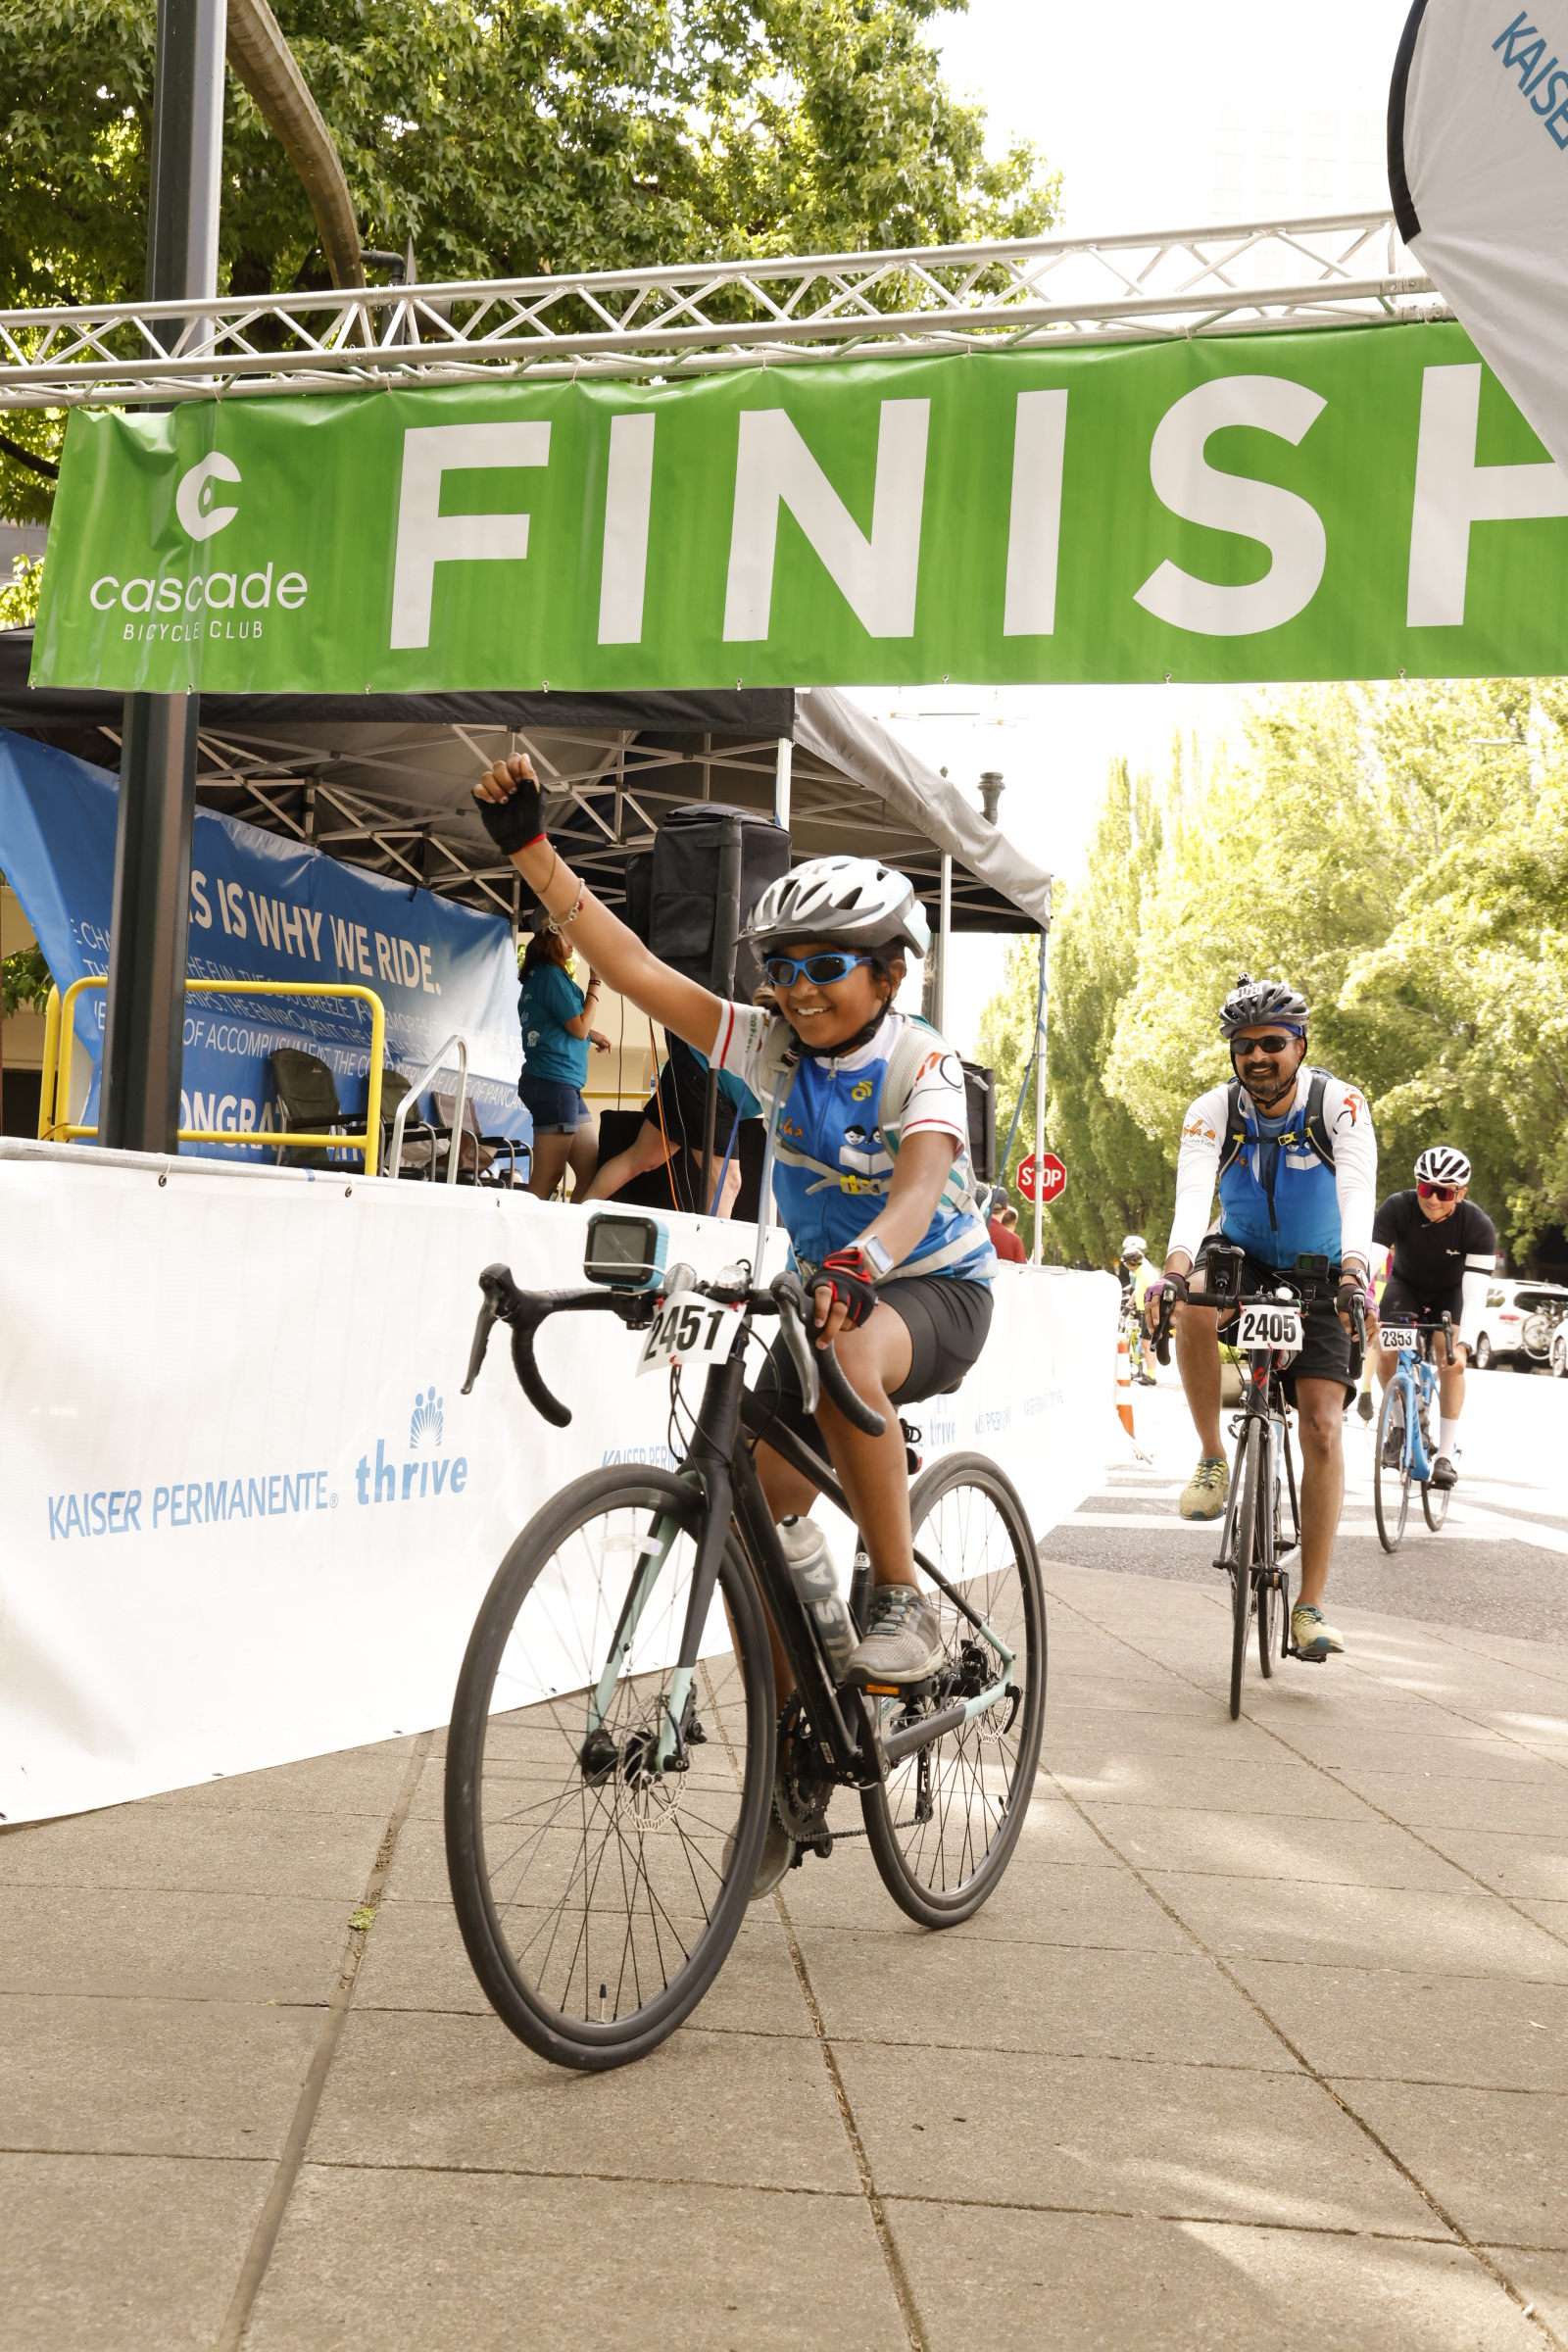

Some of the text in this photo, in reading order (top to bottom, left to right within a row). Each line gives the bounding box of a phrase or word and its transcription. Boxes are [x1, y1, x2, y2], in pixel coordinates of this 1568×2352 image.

[390, 364, 1568, 650] FINISH
[89, 563, 308, 612] cascade
[122, 620, 264, 643] BICYCLE CLUB
[218, 878, 247, 940] IS
[248, 890, 322, 962] WHY
[330, 914, 373, 977] WE
[375, 931, 441, 996] RIDE.
[183, 1018, 205, 1047] OF
[334, 1050, 358, 1076] THE
[1021, 1166, 1062, 1188] SOP
[644, 1304, 725, 1362] 2451
[1243, 1313, 1297, 1343] 2405
[1382, 1330, 1413, 1347] 2353
[48, 1490, 142, 1541] KAISER
[357, 1439, 467, 1505] thrive
